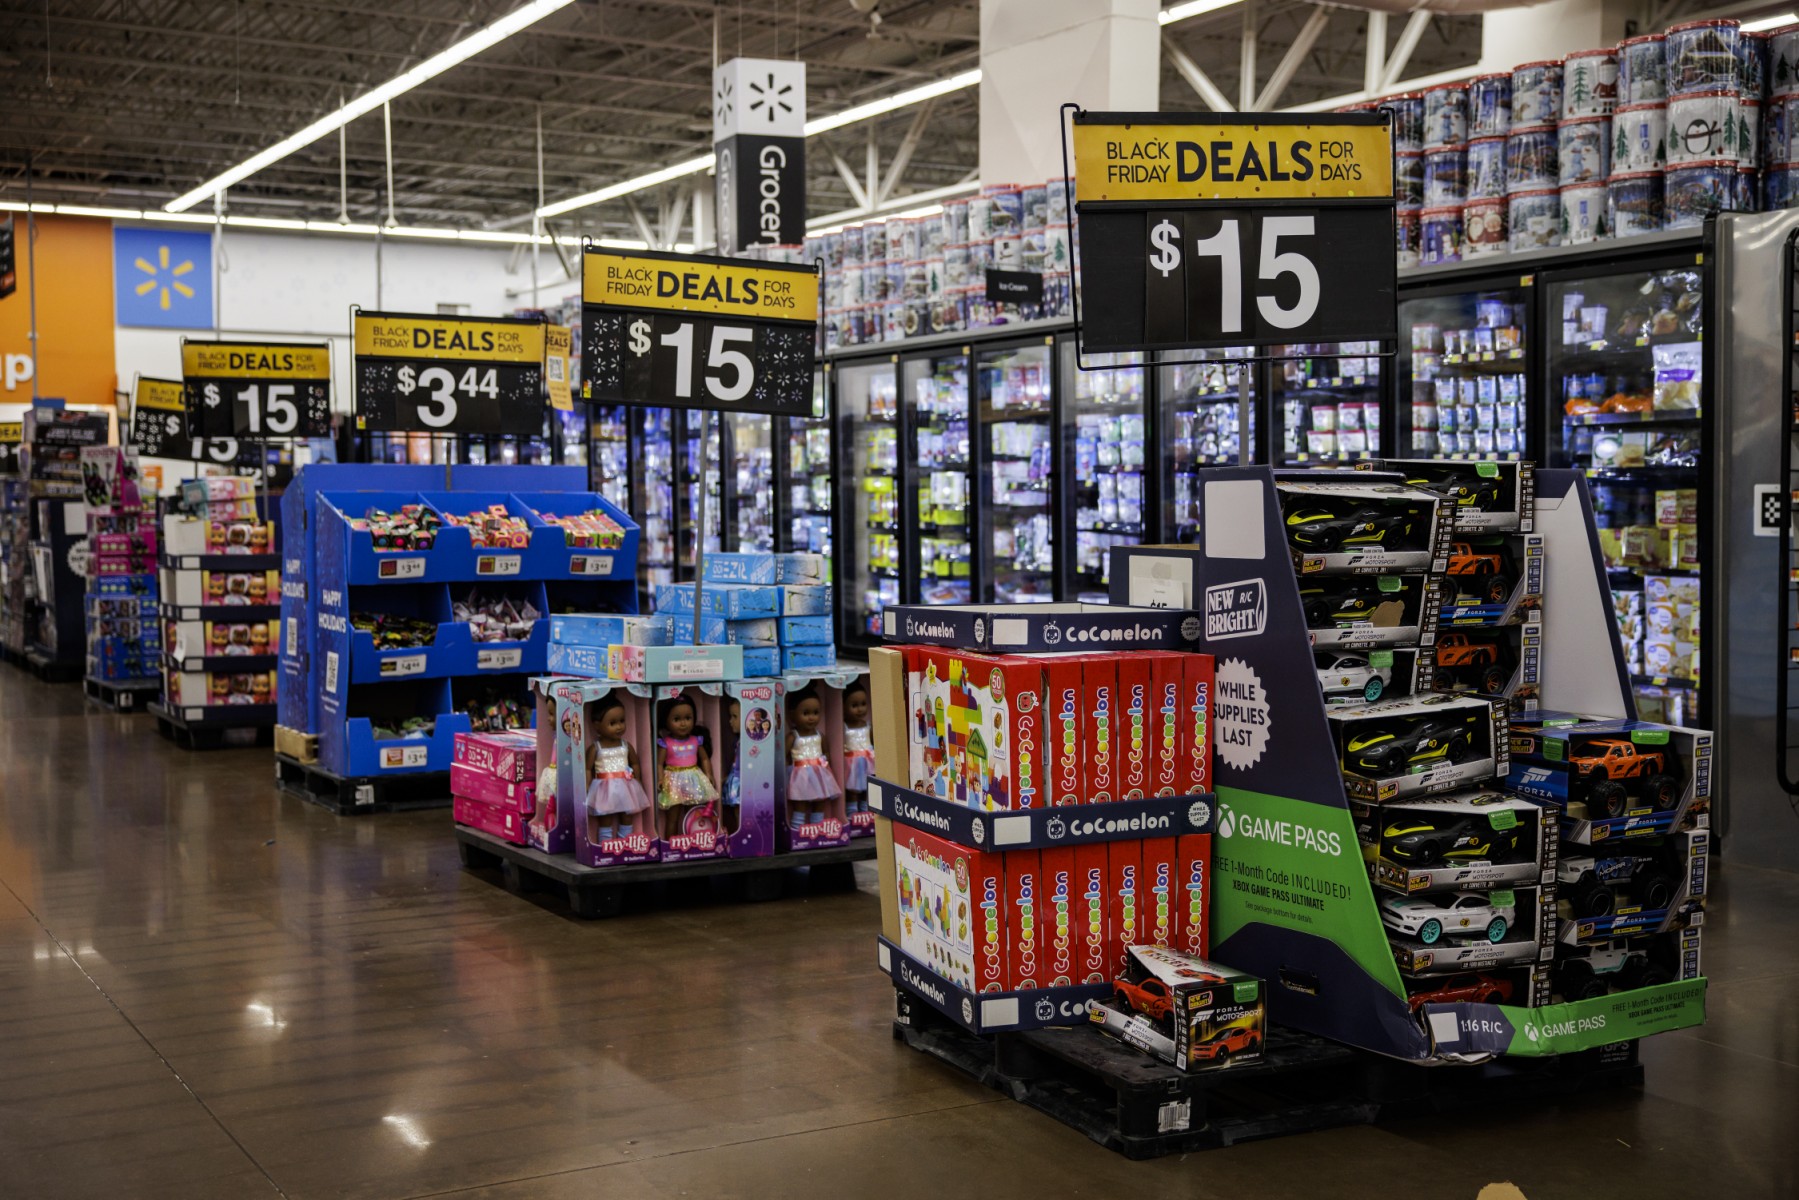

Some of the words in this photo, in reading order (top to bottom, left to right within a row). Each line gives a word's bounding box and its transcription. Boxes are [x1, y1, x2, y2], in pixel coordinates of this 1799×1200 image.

[1107, 141, 1170, 160] BLACK
[1320, 141, 1354, 159] FOR
[1175, 140, 1314, 182] DEALS
[1108, 165, 1170, 183] FRIDAY
[1320, 163, 1362, 181] DAYS
[759, 145, 786, 246] Grocer
[607, 266, 653, 282] BLACK
[606, 281, 653, 297] FRIDAY
[656, 270, 759, 305] DEALS
[763, 280, 791, 294] FOR
[762, 295, 796, 309] DAYS
[373, 326, 410, 338] BLACK
[413, 328, 494, 352] DEALS
[498, 332, 519, 342] FOR
[373, 337, 411, 349] FRIDAY
[498, 343, 524, 354] DAYS
[197, 352, 227, 361] BLACK
[197, 361, 227, 370] FRIDAY
[229, 353, 294, 371] DEALS
[285, 559, 300, 574] HAPPY
[283, 582, 305, 598] HOLIDAYS
[322, 589, 342, 607] HAPPY
[1208, 589, 1235, 612] NEW
[1239, 591, 1253, 604] R/C
[318, 612, 347, 633] HOLIDAYS
[1208, 609, 1256, 634] BRIGHT
[1065, 623, 1163, 643] CoComelon
[992, 675, 1002, 689] 50
[1218, 680, 1256, 702] WHILE
[1213, 702, 1265, 726] SUPPLIES
[1222, 727, 1253, 747] LAST
[1018, 716, 1036, 809] CoComelo
[1435, 771, 1464, 782] MOTORSPORT
[1517, 785, 1553, 798] FORZA
[1070, 815, 1170, 836] CoComelon
[1240, 814, 1292, 846] GAME
[1295, 825, 1341, 857] PASS
[956, 864, 965, 879] 50
[1473, 872, 1505, 880] MOTORSPORT
[1599, 861, 1626, 877] MOPAR
[1211, 856, 1229, 872] REE
[1230, 860, 1264, 880] 1-Month
[1266, 868, 1289, 886] Code
[1291, 873, 1351, 901] INCLUDED!
[1232, 879, 1251, 893] XBOX
[1251, 883, 1270, 898] GAME
[1272, 888, 1290, 902] PASS
[1291, 893, 1325, 911] ULTIMATE
[1216, 1005, 1244, 1014] FORZA
[1612, 1003, 1626, 1013] FREE
[1650, 995, 1664, 1005] Code
[1216, 1008, 1263, 1022] MOTORSPORT
[1461, 1018, 1480, 1033] 1:16
[1482, 1021, 1503, 1035] R/C
[1542, 1019, 1578, 1039] GAME
[1579, 1015, 1606, 1031] PASS
